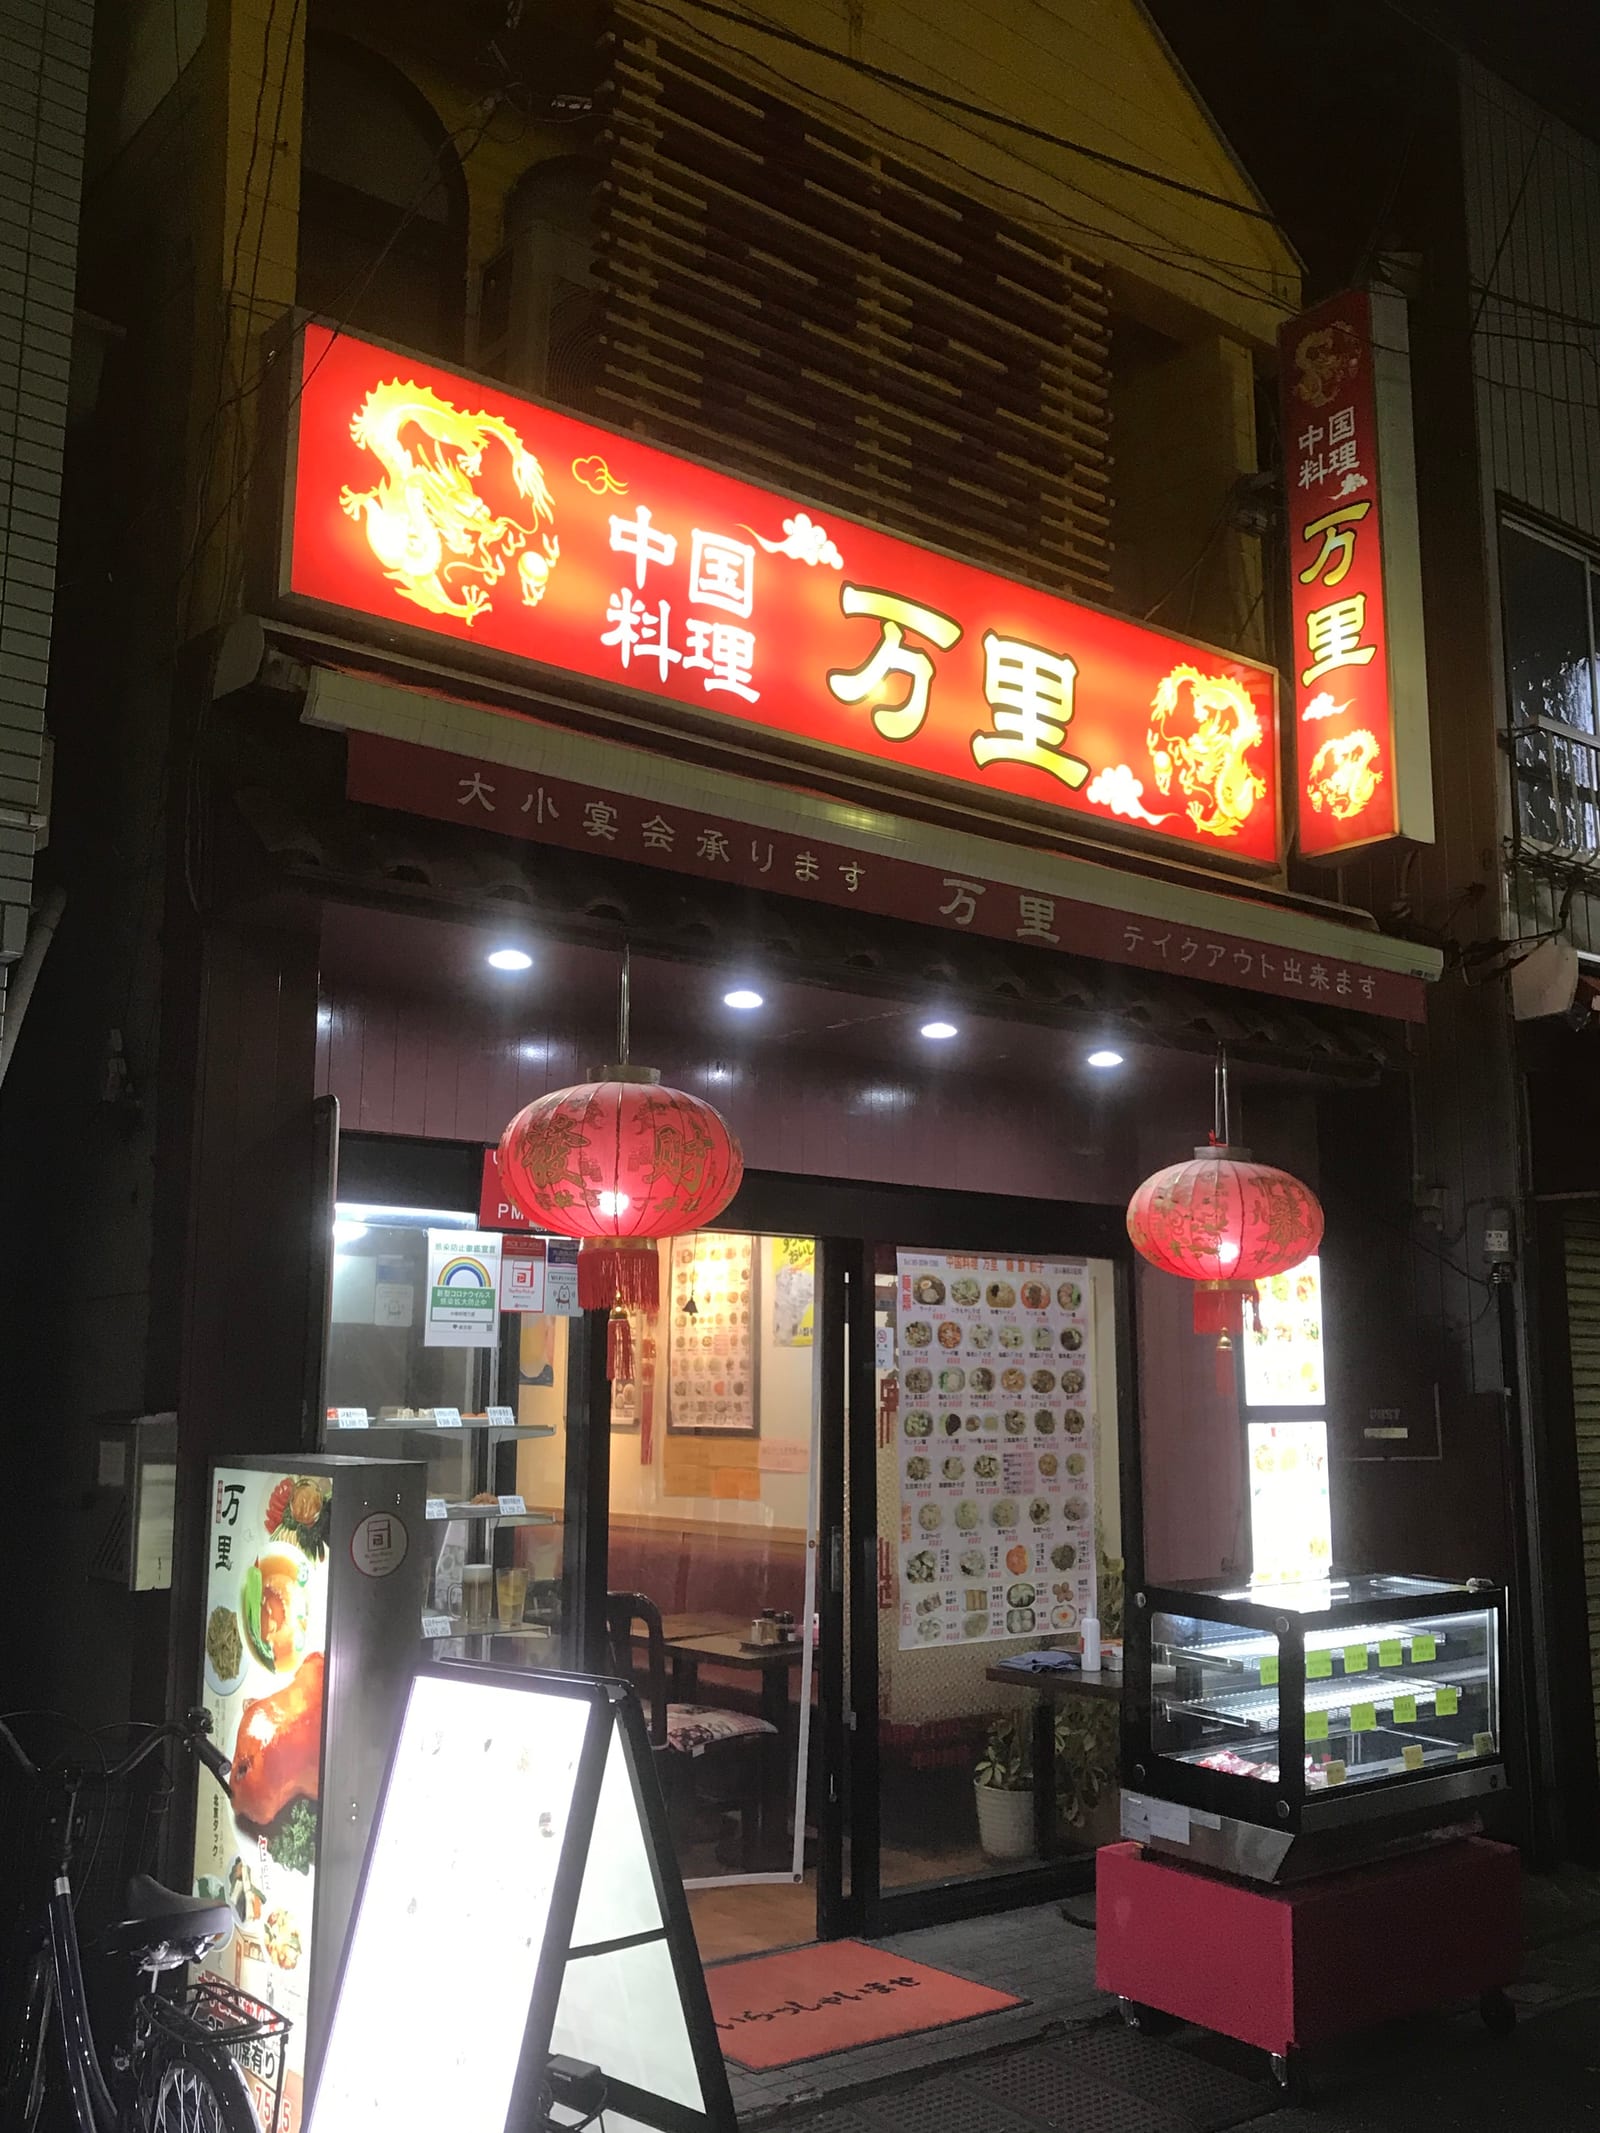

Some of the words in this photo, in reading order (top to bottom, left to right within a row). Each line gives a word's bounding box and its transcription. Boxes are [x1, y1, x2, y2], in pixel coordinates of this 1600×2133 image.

[1298, 407, 1355, 457] 中国
[1298, 445, 1361, 489] 料理
[608, 505, 757, 619] 中国
[1299, 500, 1379, 689] 万里
[600, 588, 761, 704] 料理
[828, 581, 1091, 790] 万里
[458, 773, 866, 893] 大小宴会承ります
[938, 877, 1061, 945] 万里
[1123, 926, 1378, 1001] テイクアウト出来ます
[437, 1289, 491, 1298] 新型コロナウイルス
[215, 1484, 246, 1571] 万里
